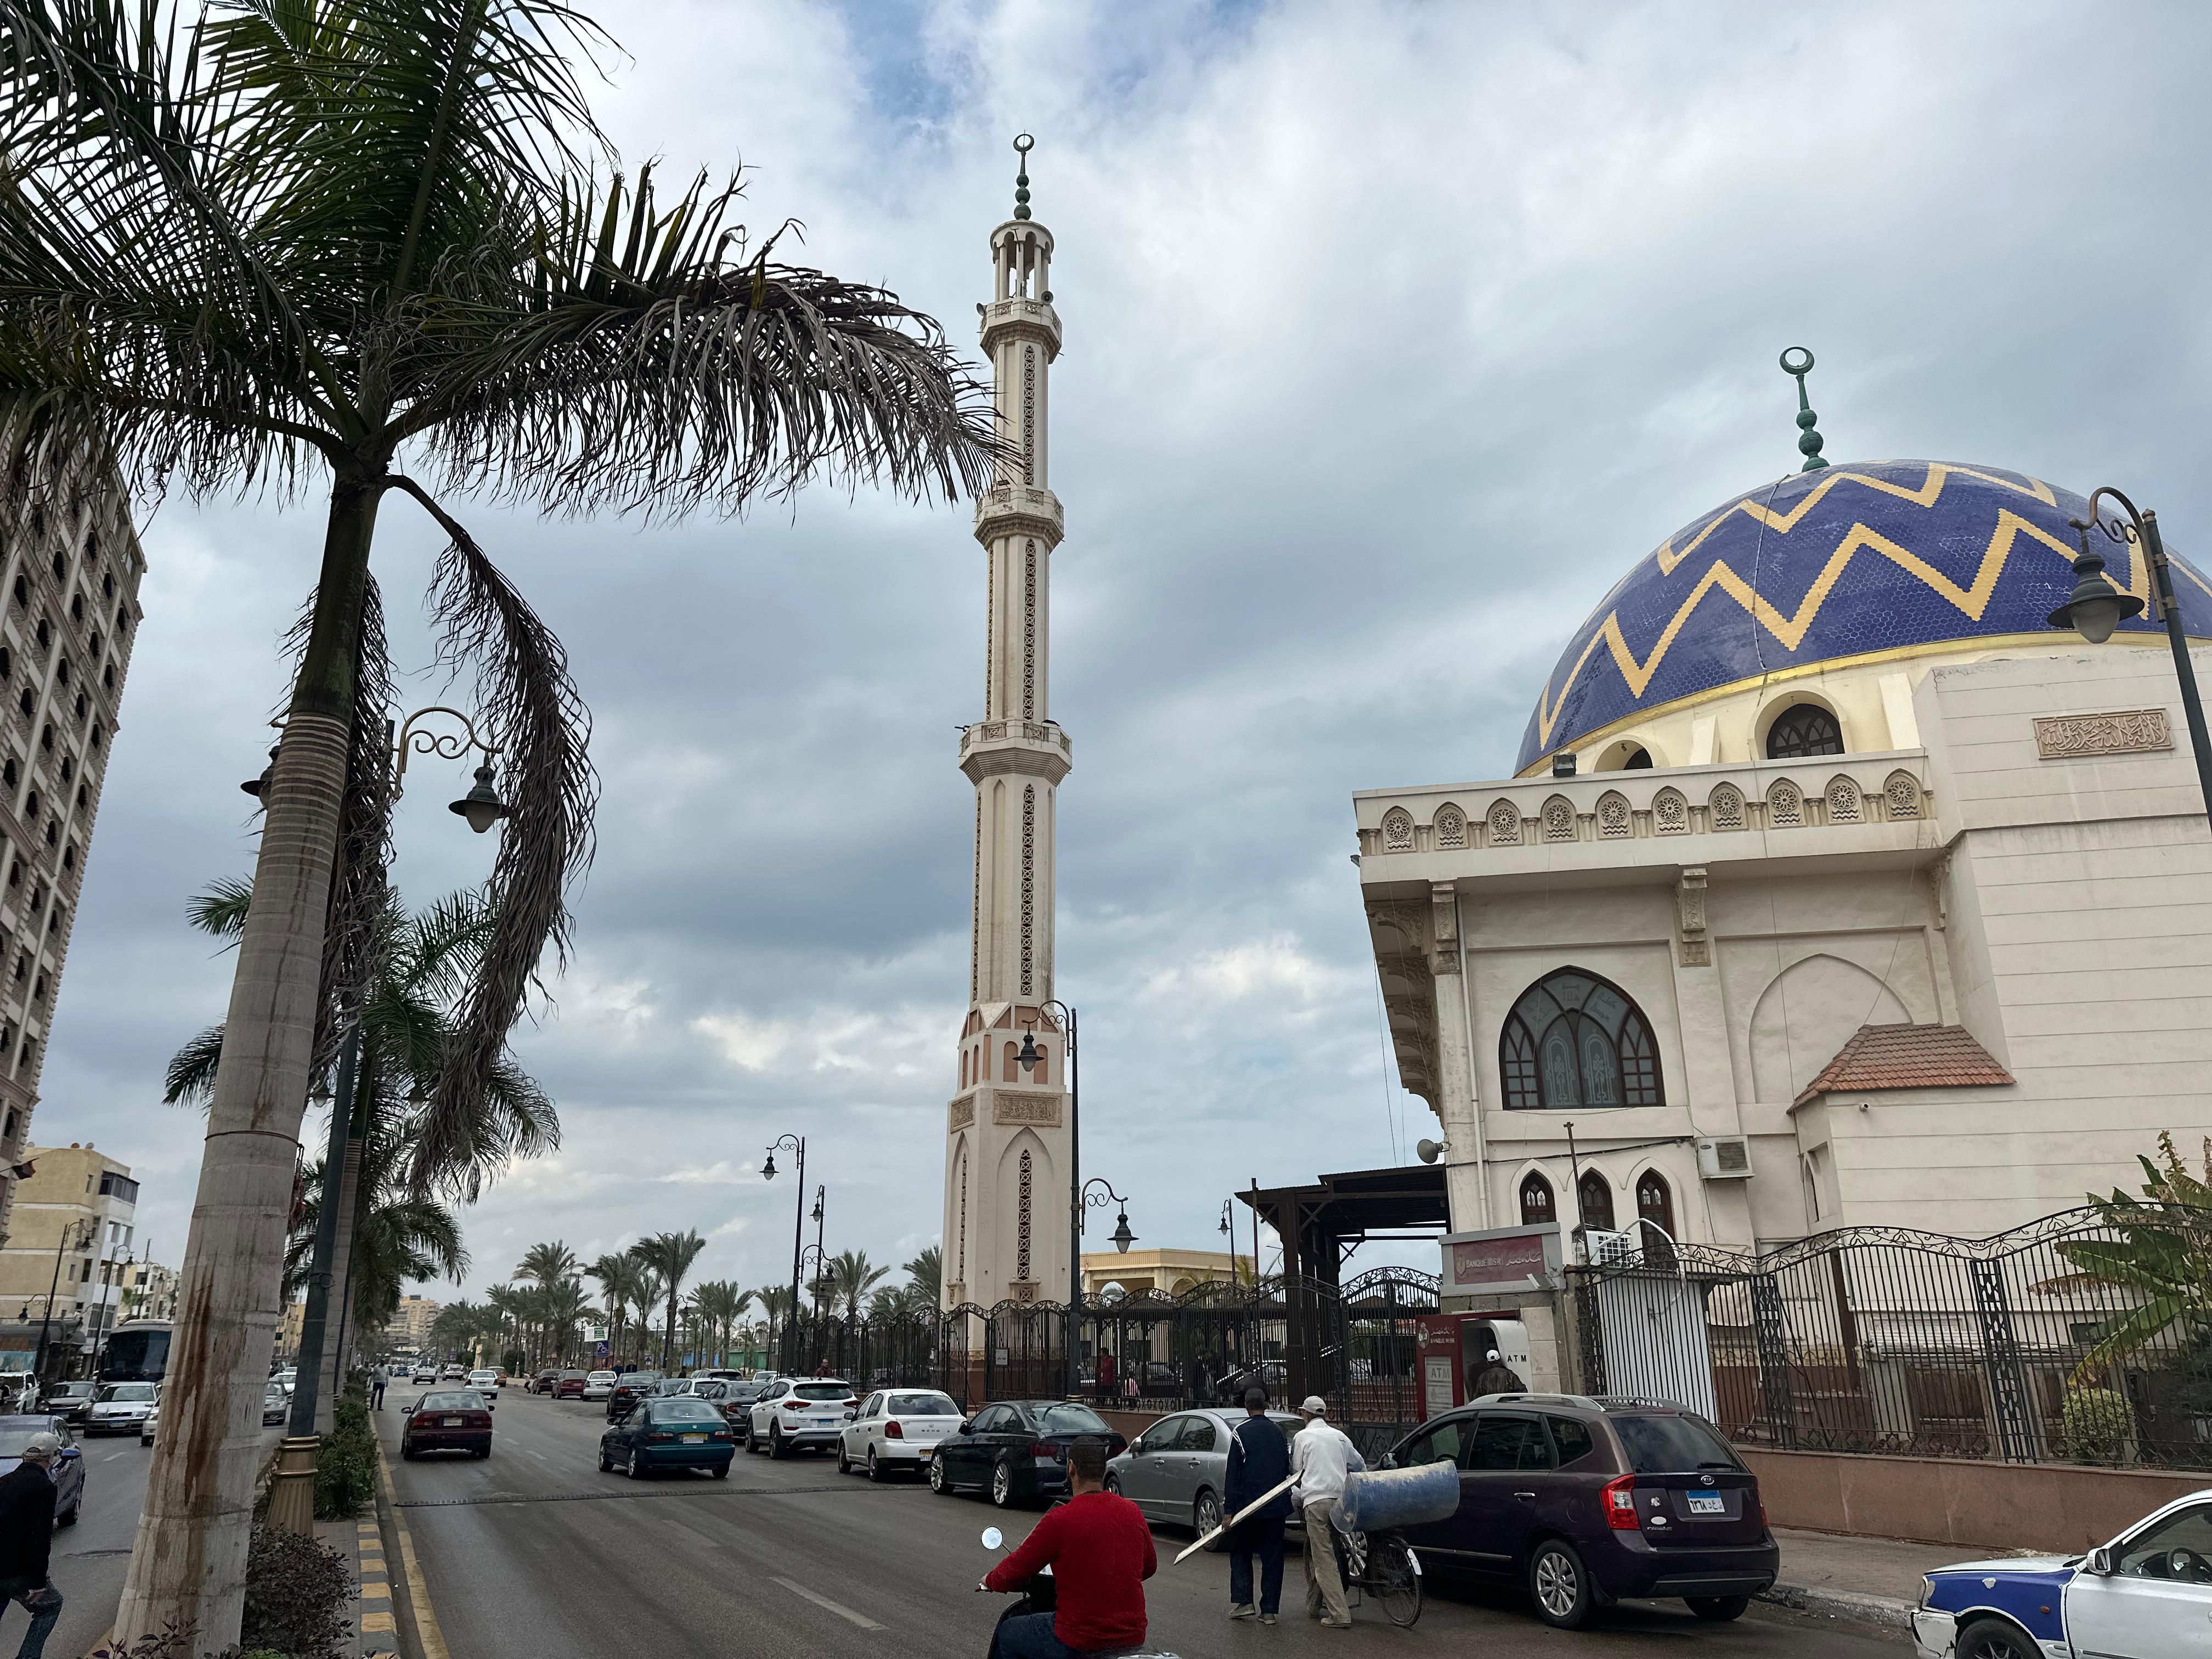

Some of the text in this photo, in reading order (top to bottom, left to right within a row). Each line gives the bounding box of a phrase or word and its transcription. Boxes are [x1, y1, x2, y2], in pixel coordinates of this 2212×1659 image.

[1466, 1257, 1502, 1269] BANQUE MISR
[1505, 1250, 1542, 1267] بنك مصر
[1507, 1355, 1527, 1363] ATM
[1431, 1367, 1450, 1379] ATM
